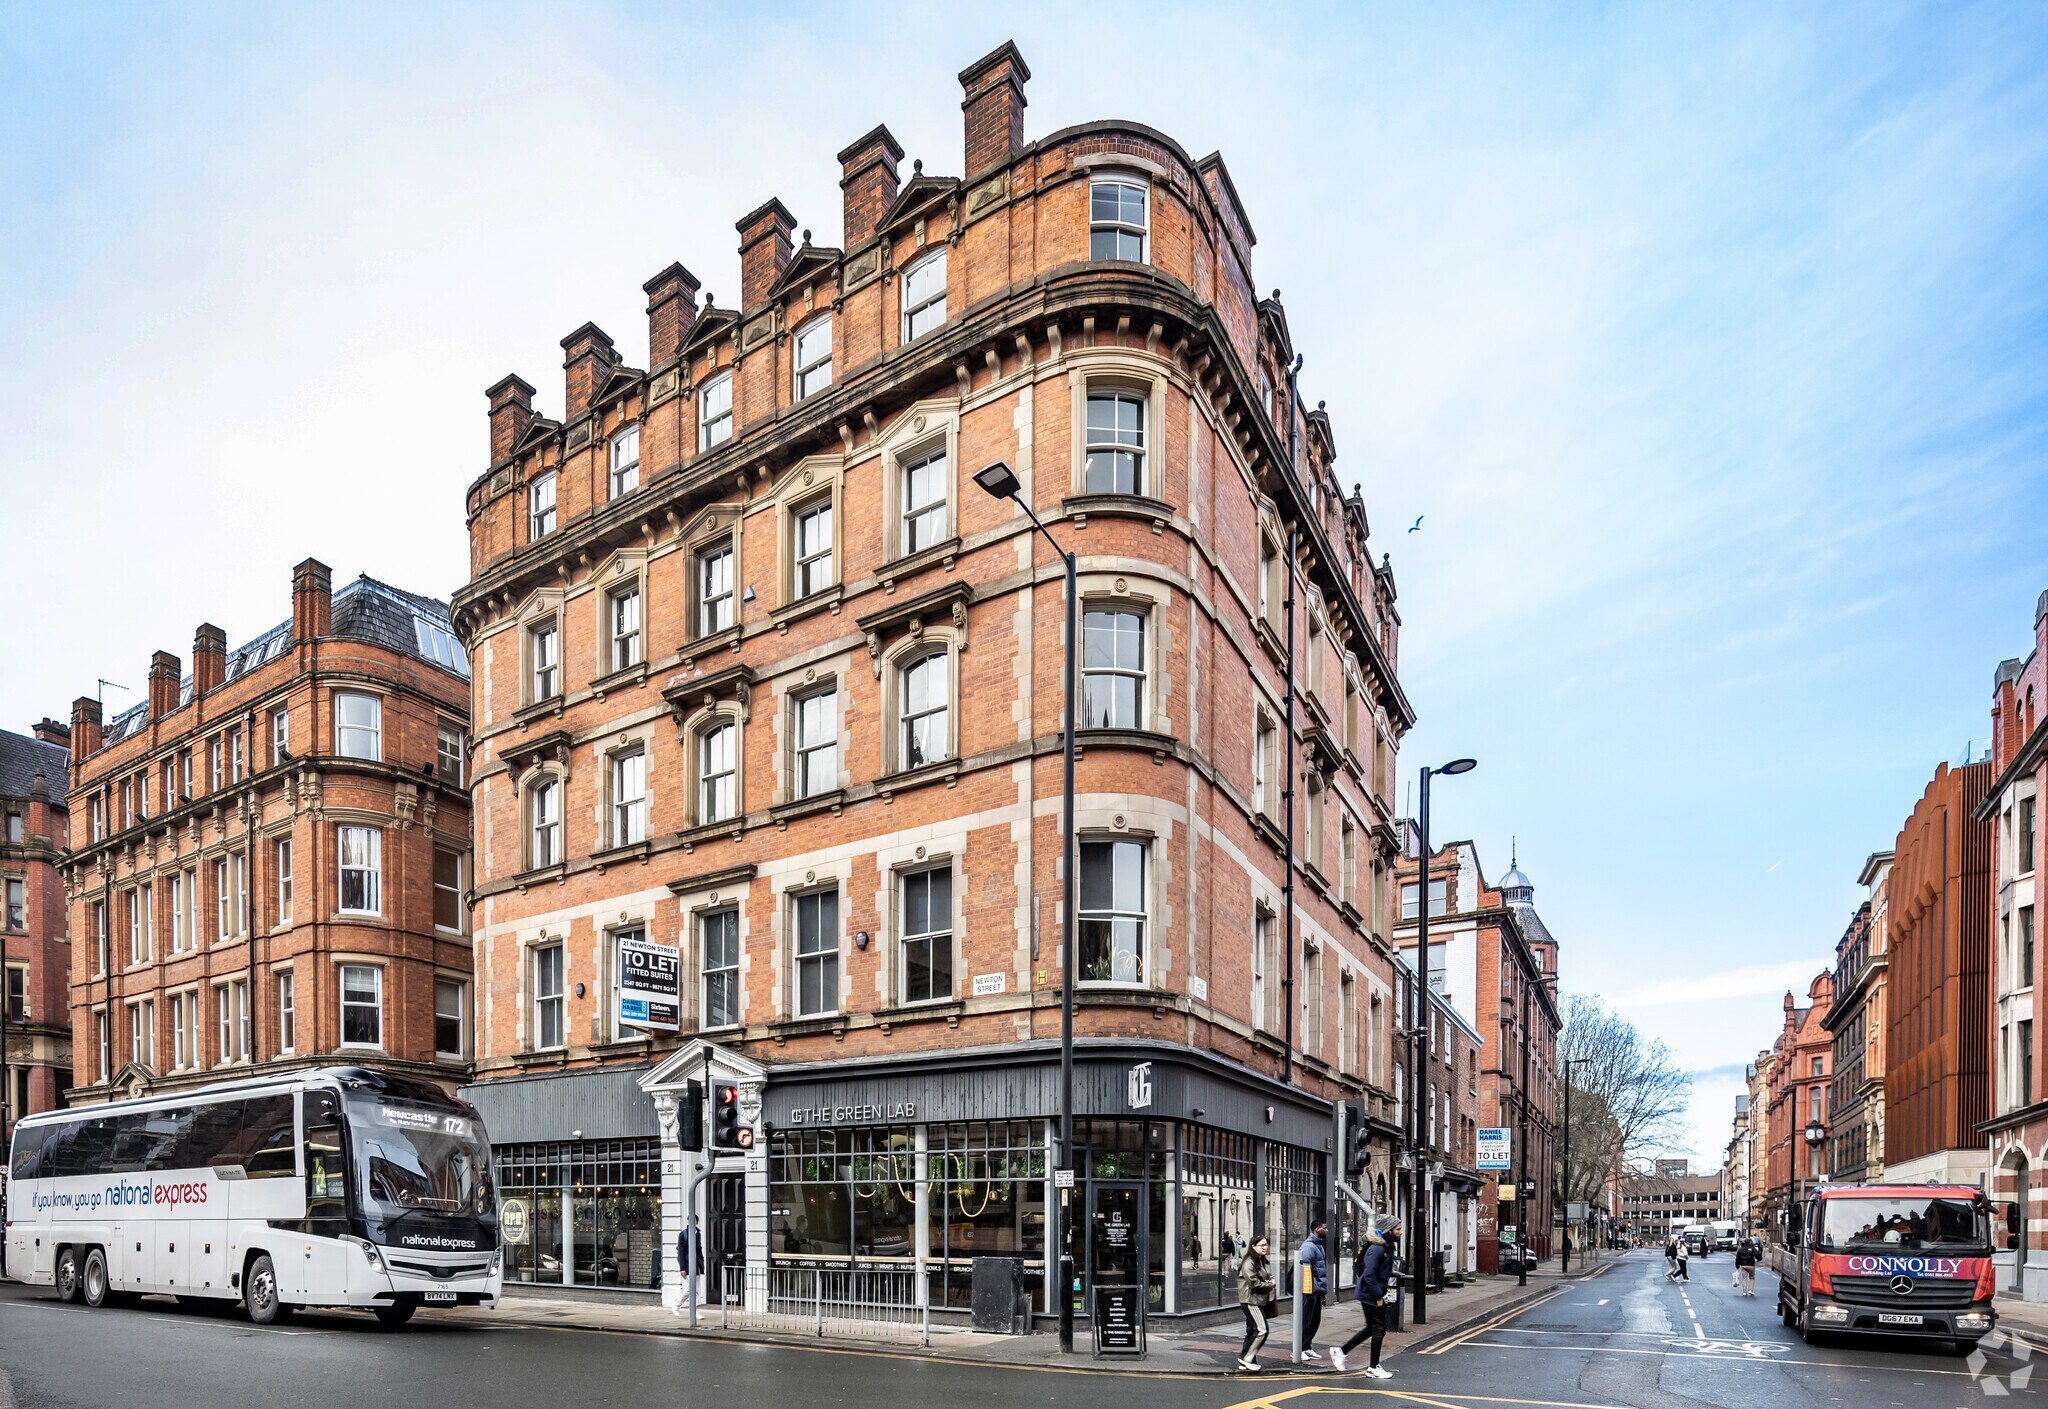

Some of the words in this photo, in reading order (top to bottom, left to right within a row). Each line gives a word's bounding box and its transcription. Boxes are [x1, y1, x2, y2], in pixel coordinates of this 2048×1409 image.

[630, 941, 656, 951] NEWTON
[657, 945, 677, 954] STREET
[622, 950, 645, 967] TO
[648, 955, 678, 973] LET
[626, 967, 649, 977] FITTED
[650, 970, 673, 981] SUITES
[975, 975, 1003, 985] NEWTON
[977, 984, 1001, 993] STREET
[382, 1107, 437, 1124] Newcastle
[804, 1107, 830, 1122] THE
[834, 1105, 882, 1120] GREEN
[887, 1102, 915, 1118] LAB
[444, 1117, 464, 1135] 172
[667, 1163, 674, 1173] 21
[750, 1160, 758, 1170] 21
[32, 1192, 37, 1207] if
[38, 1194, 51, 1211] you
[74, 1194, 89, 1211] you
[91, 1193, 101, 1210] go
[105, 1178, 152, 1205] national
[154, 1183, 207, 1211] express
[402, 1234, 440, 1246] national
[441, 1238, 476, 1249] express
[1848, 1256, 1963, 1273] CONNOLLY
